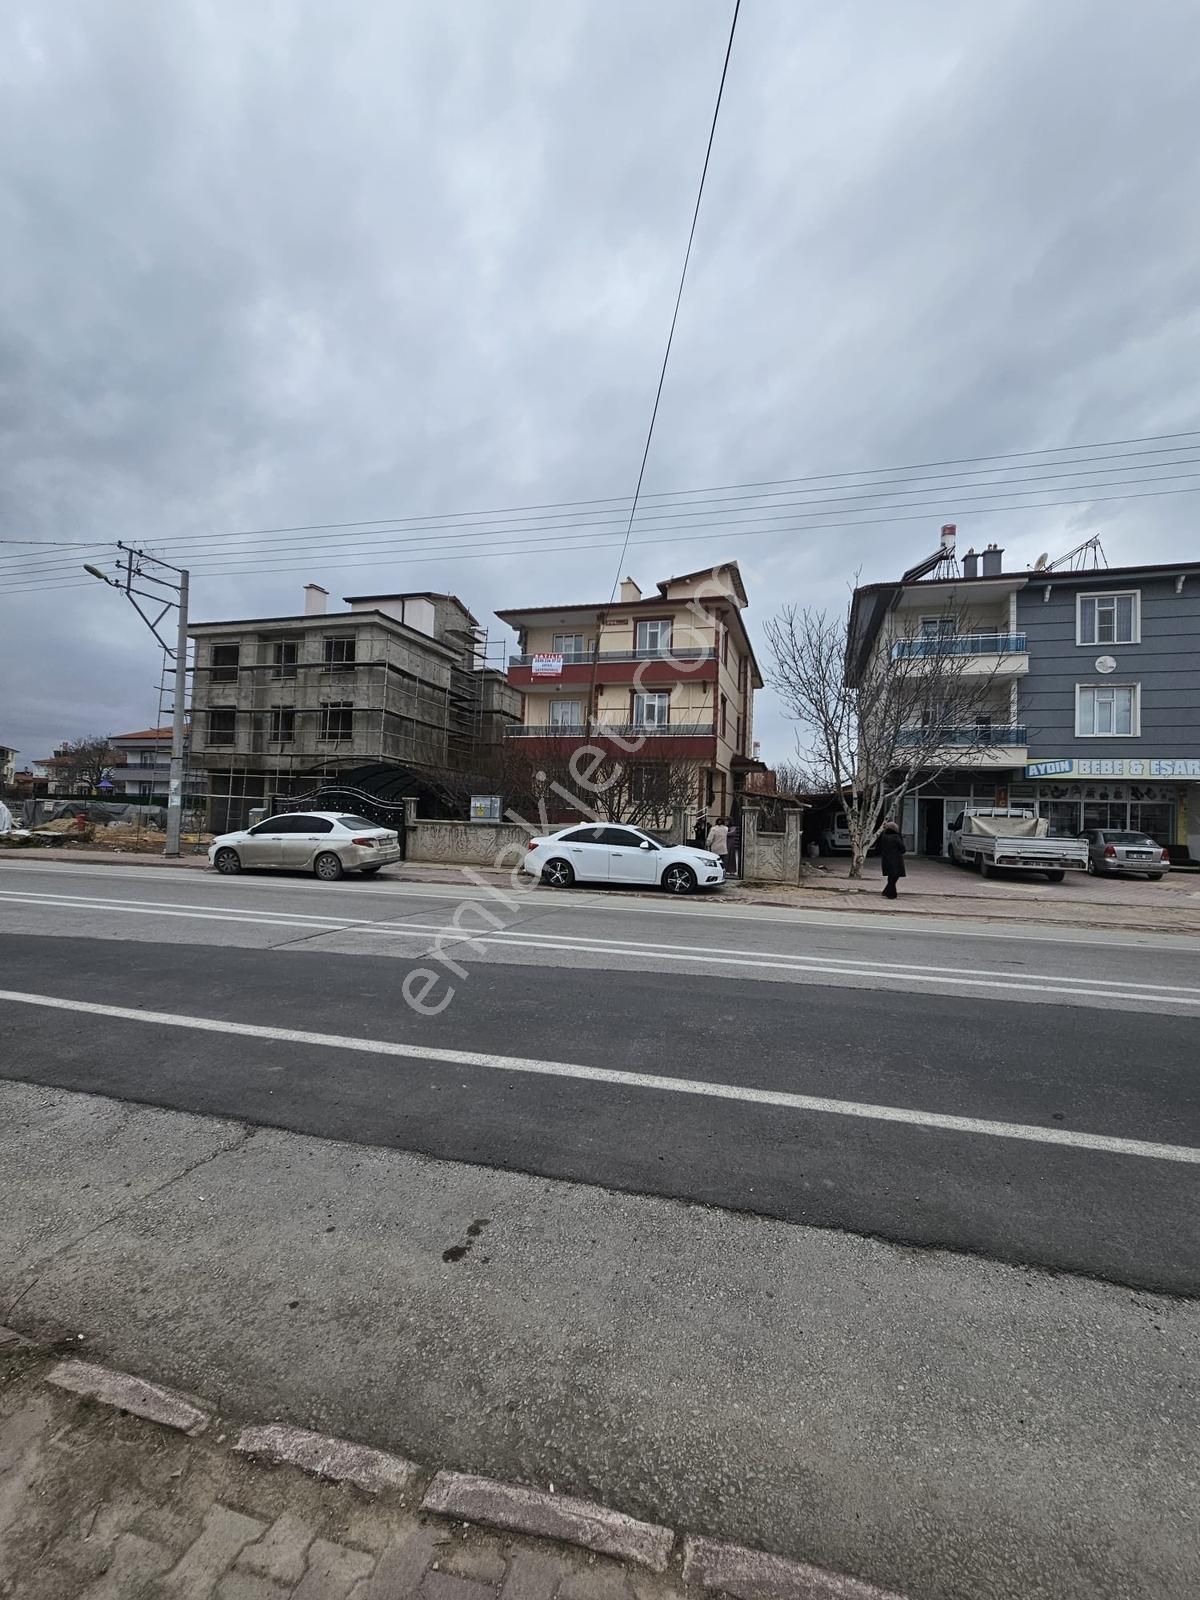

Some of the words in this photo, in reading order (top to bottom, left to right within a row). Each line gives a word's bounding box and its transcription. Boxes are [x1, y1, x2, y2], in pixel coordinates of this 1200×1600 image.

[1028, 760, 1071, 777] AYDIN
[1078, 759, 1124, 775] BEBE
[1129, 759, 1145, 776] &
